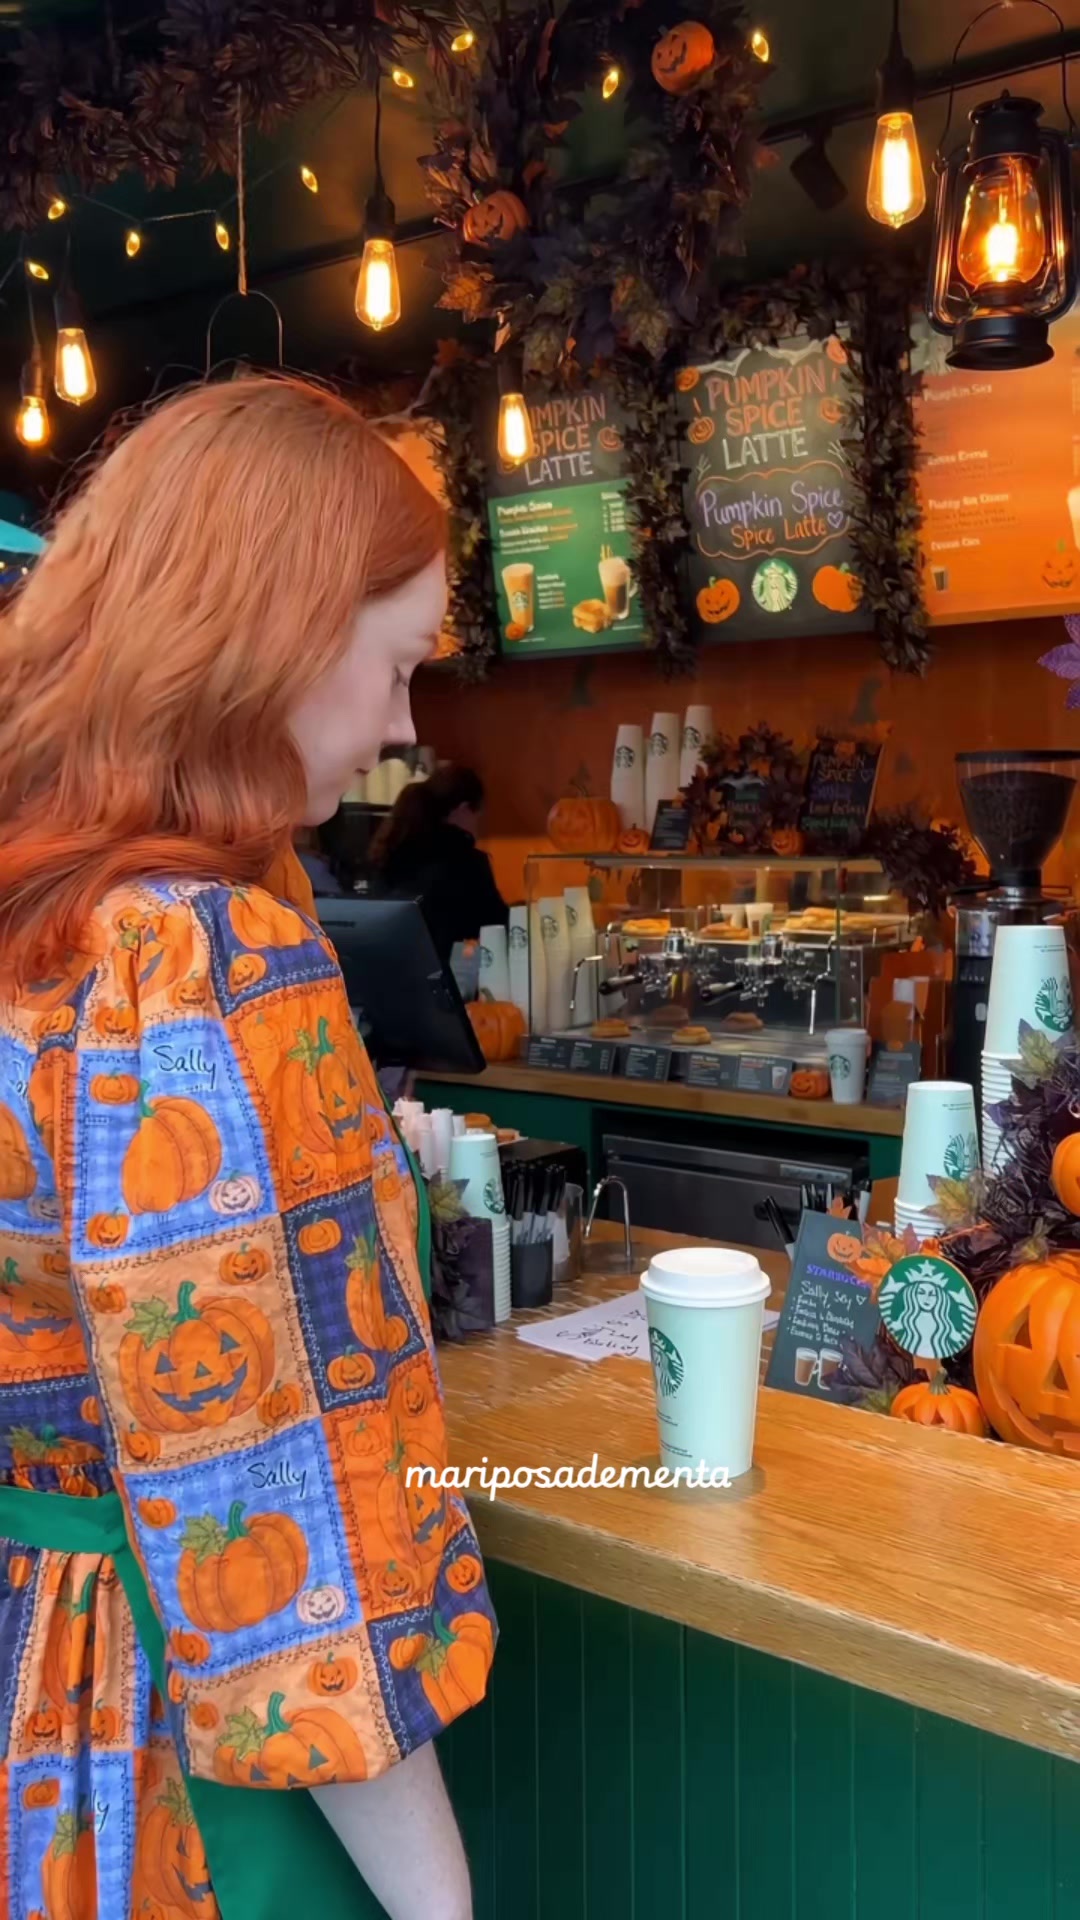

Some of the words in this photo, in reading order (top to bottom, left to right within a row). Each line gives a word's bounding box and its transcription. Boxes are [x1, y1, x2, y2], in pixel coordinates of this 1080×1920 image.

[706, 359, 825, 410] PUMPKIN
[530, 393, 606, 430] MPKIN
[726, 397, 803, 437] SPICE
[524, 451, 594, 486] LATTE
[722, 427, 809, 470] LATTE
[700, 489, 783, 528] Pumpkin
[790, 480, 844, 515] Spice
[730, 523, 775, 550] Spice
[783, 514, 827, 540] Latte
[153, 1045, 217, 1090] Sally
[247, 1461, 307, 1498] Sally
